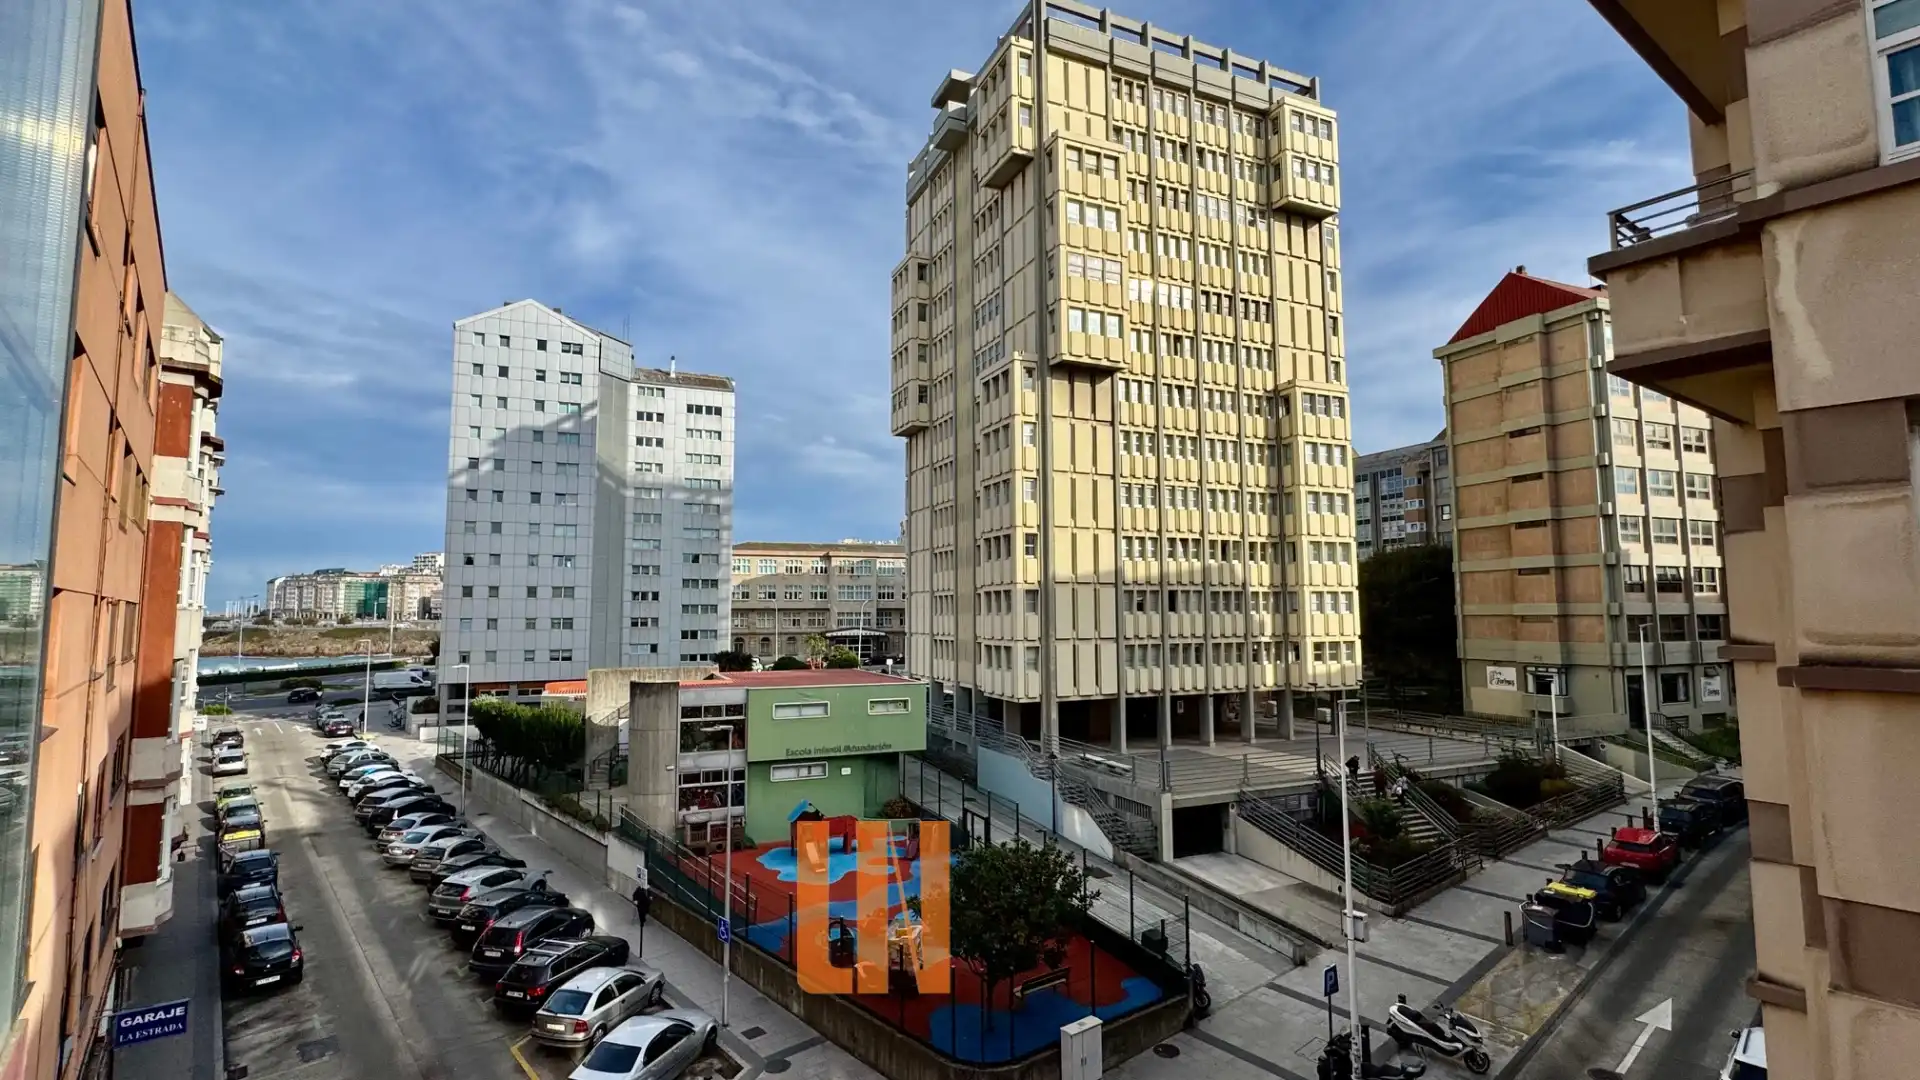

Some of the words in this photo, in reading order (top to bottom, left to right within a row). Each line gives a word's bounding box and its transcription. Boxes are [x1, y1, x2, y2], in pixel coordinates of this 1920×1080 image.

[785, 747, 812, 757] Escola
[120, 1006, 186, 1028] GARAJE
[119, 1033, 133, 1043] LA
[135, 1022, 184, 1039] ESTRADA
